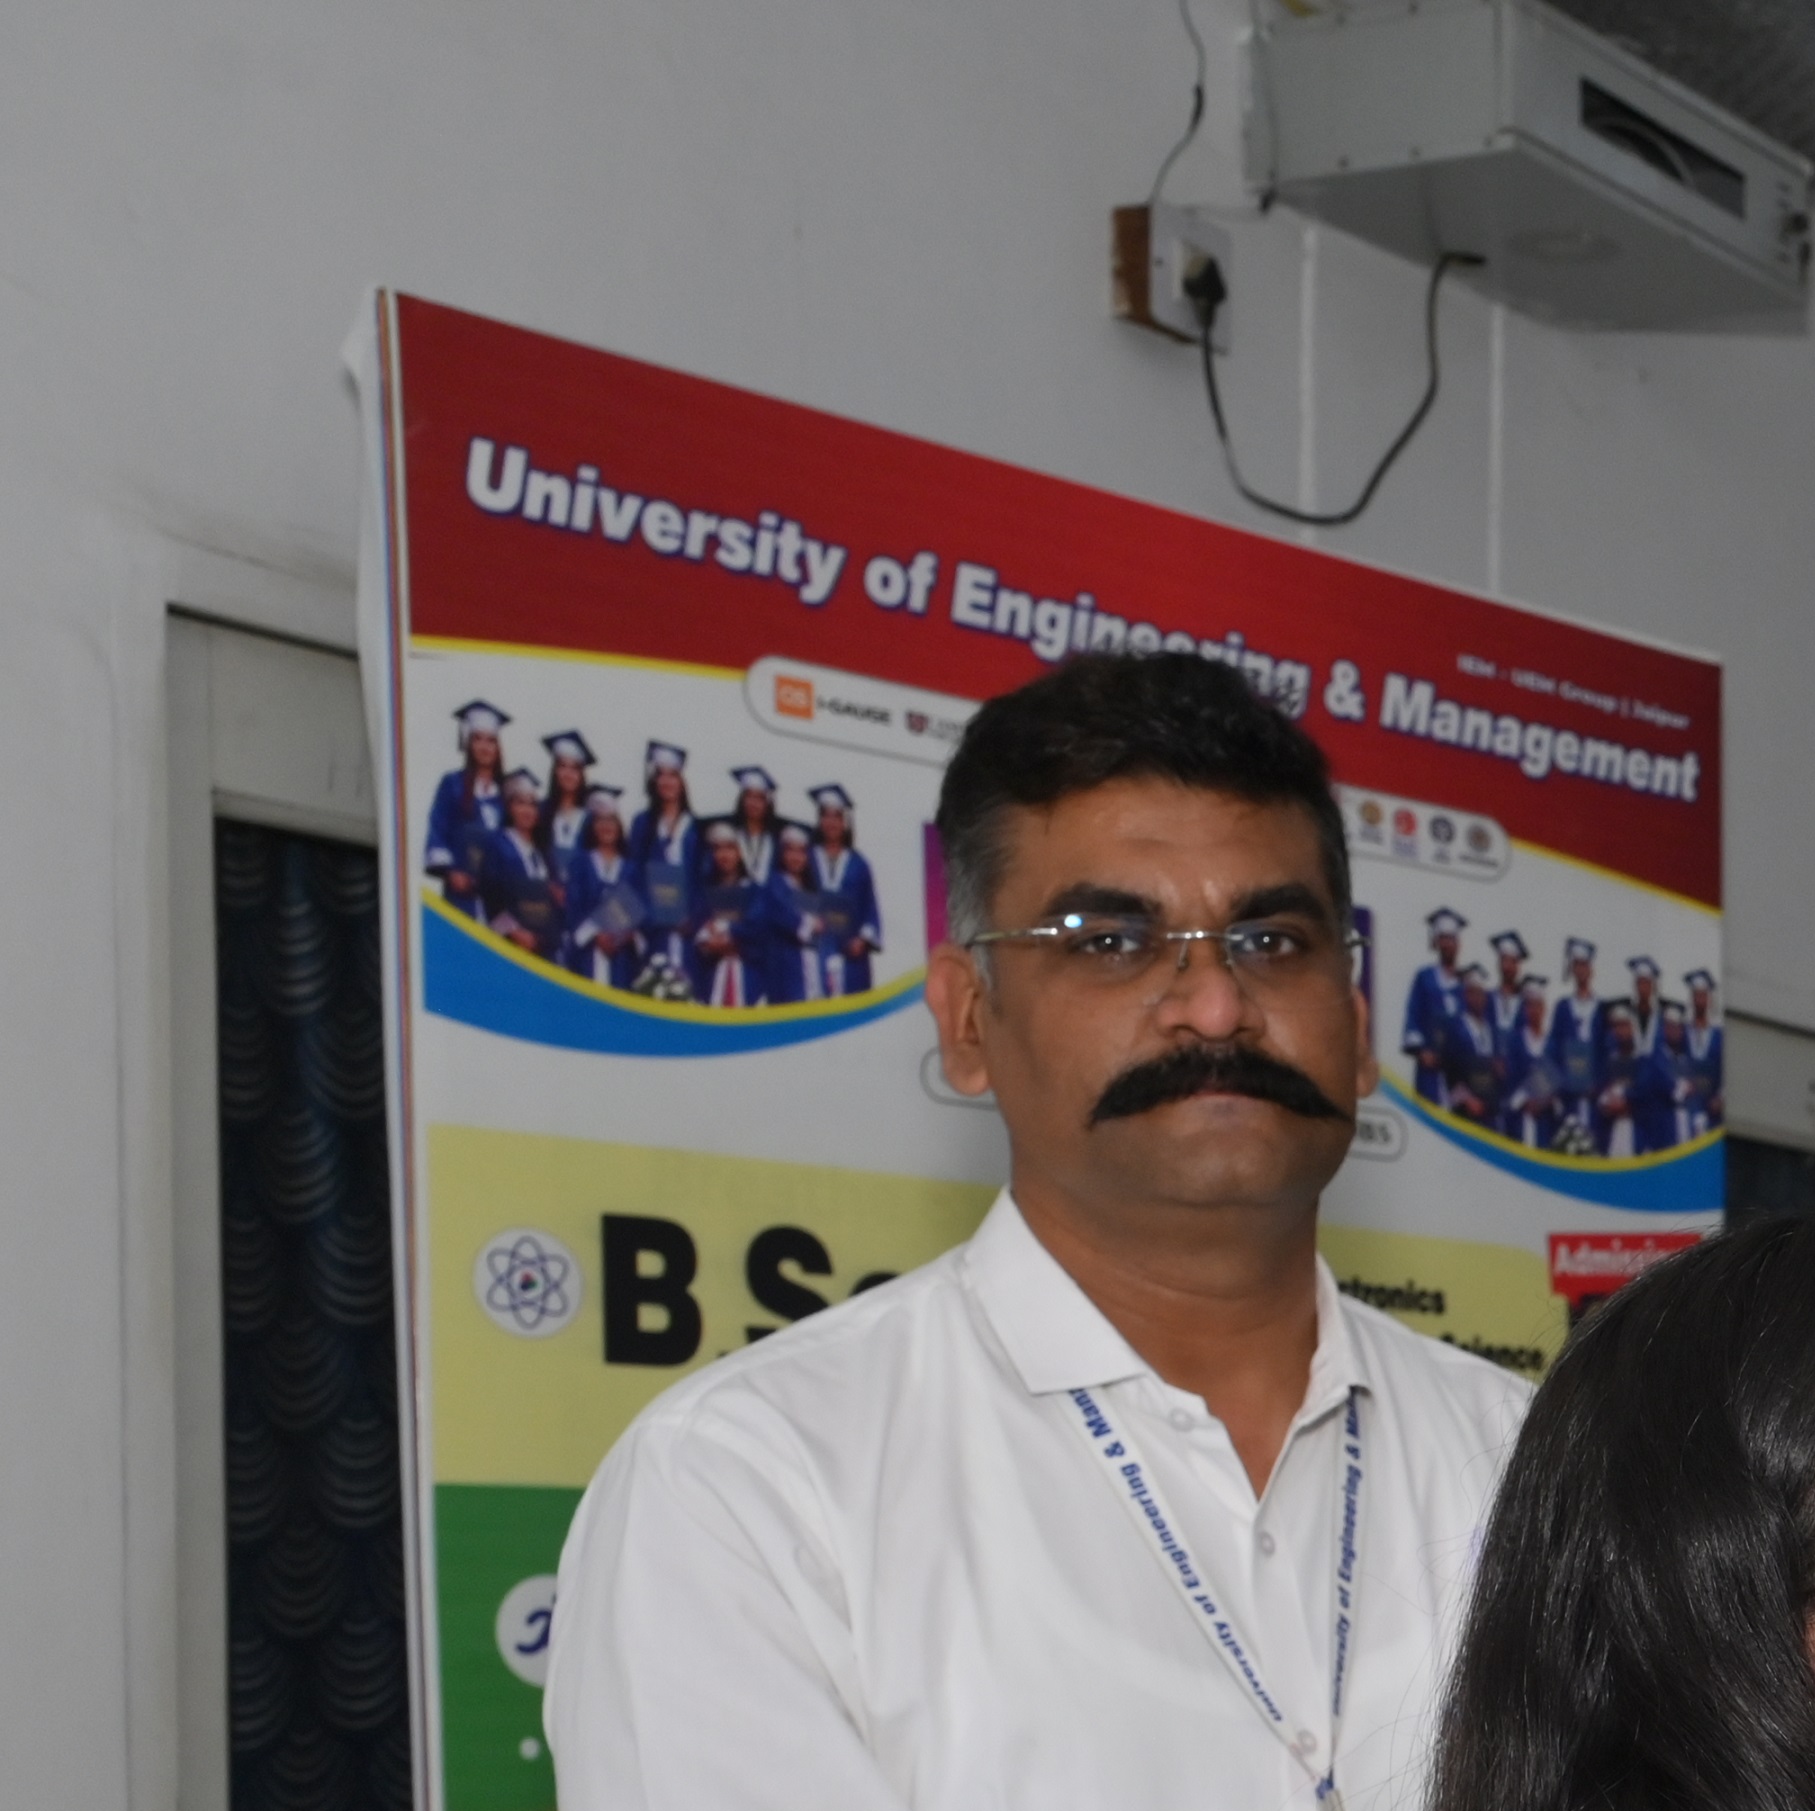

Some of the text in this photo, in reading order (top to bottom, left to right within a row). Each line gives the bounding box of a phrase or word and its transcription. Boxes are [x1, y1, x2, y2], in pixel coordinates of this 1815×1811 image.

[466, 437, 848, 606] University
[863, 550, 939, 614] of
[1324, 658, 1365, 721] &
[1380, 673, 1702, 803] Management
[1103, 1440, 1126, 1459] &
[1119, 1461, 1201, 1590] Engineering
[1193, 1594, 1217, 1615] of
